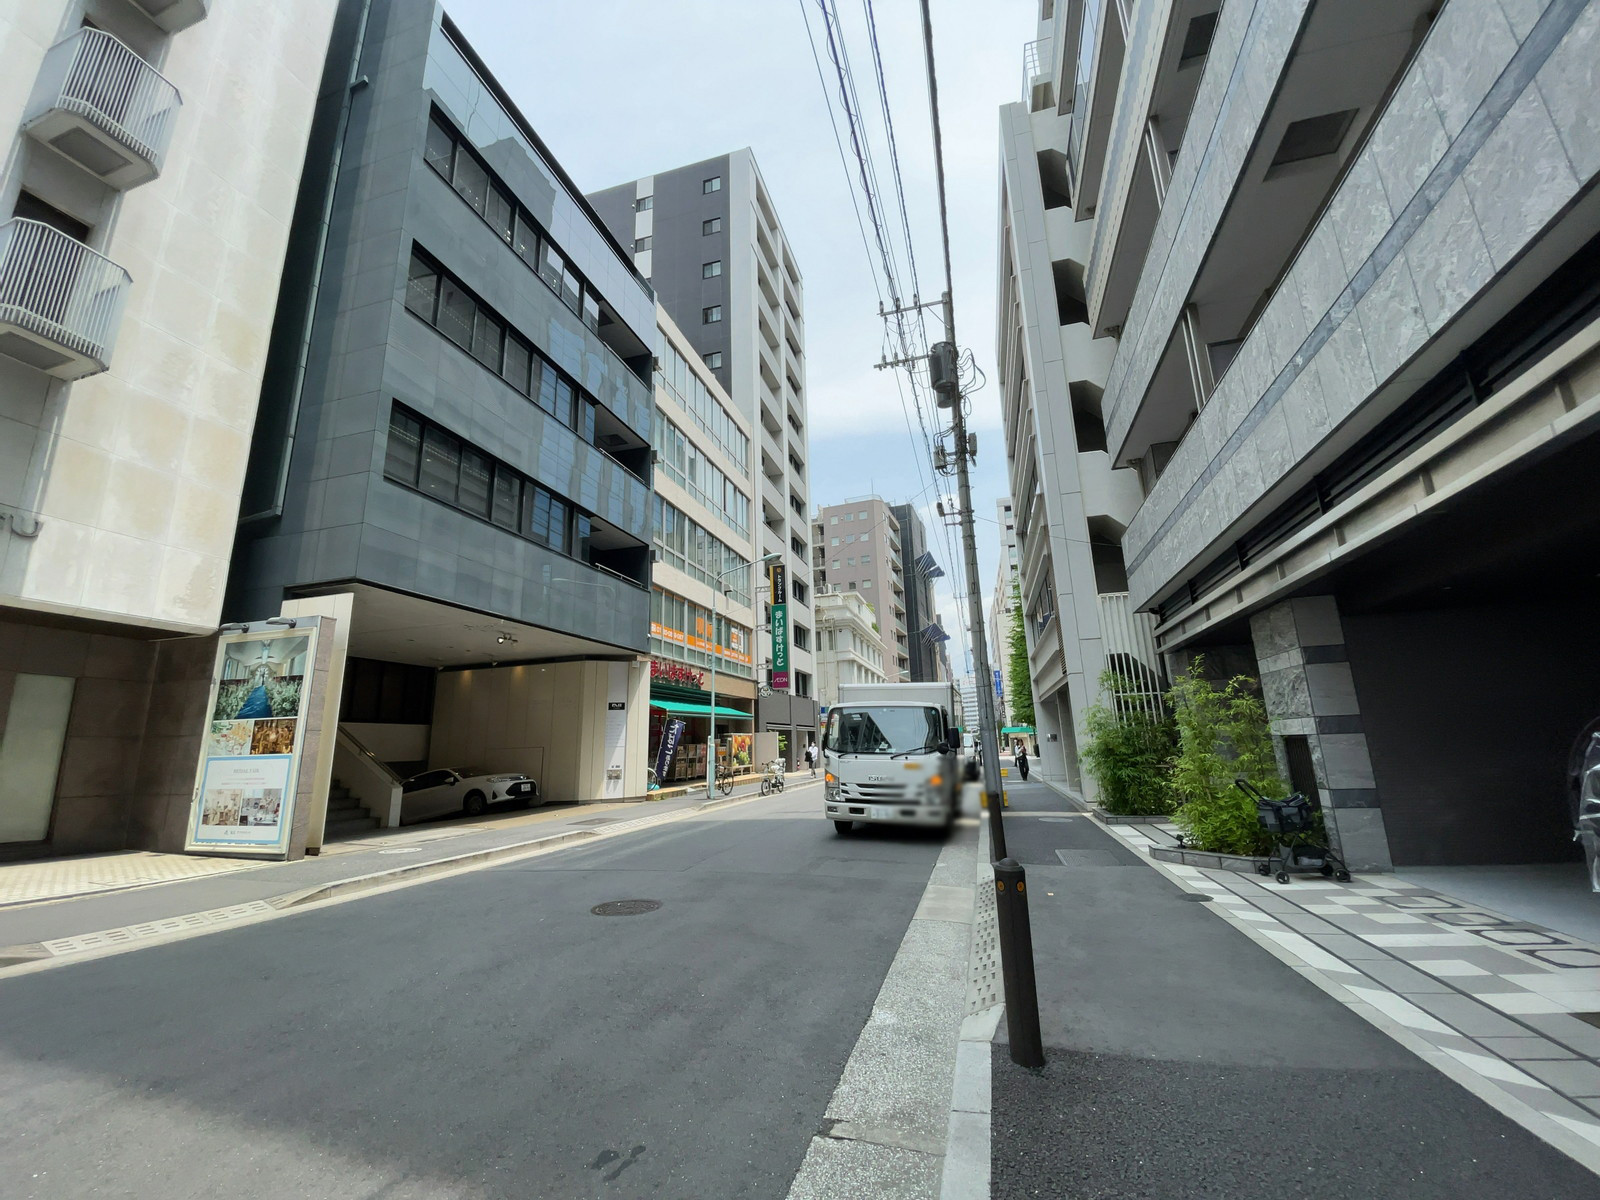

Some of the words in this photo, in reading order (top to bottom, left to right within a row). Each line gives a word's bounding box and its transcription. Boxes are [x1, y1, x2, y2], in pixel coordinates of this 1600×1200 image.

[775, 610, 784, 667] まいばすけっと
[650, 660, 704, 686] まいばすけっと
